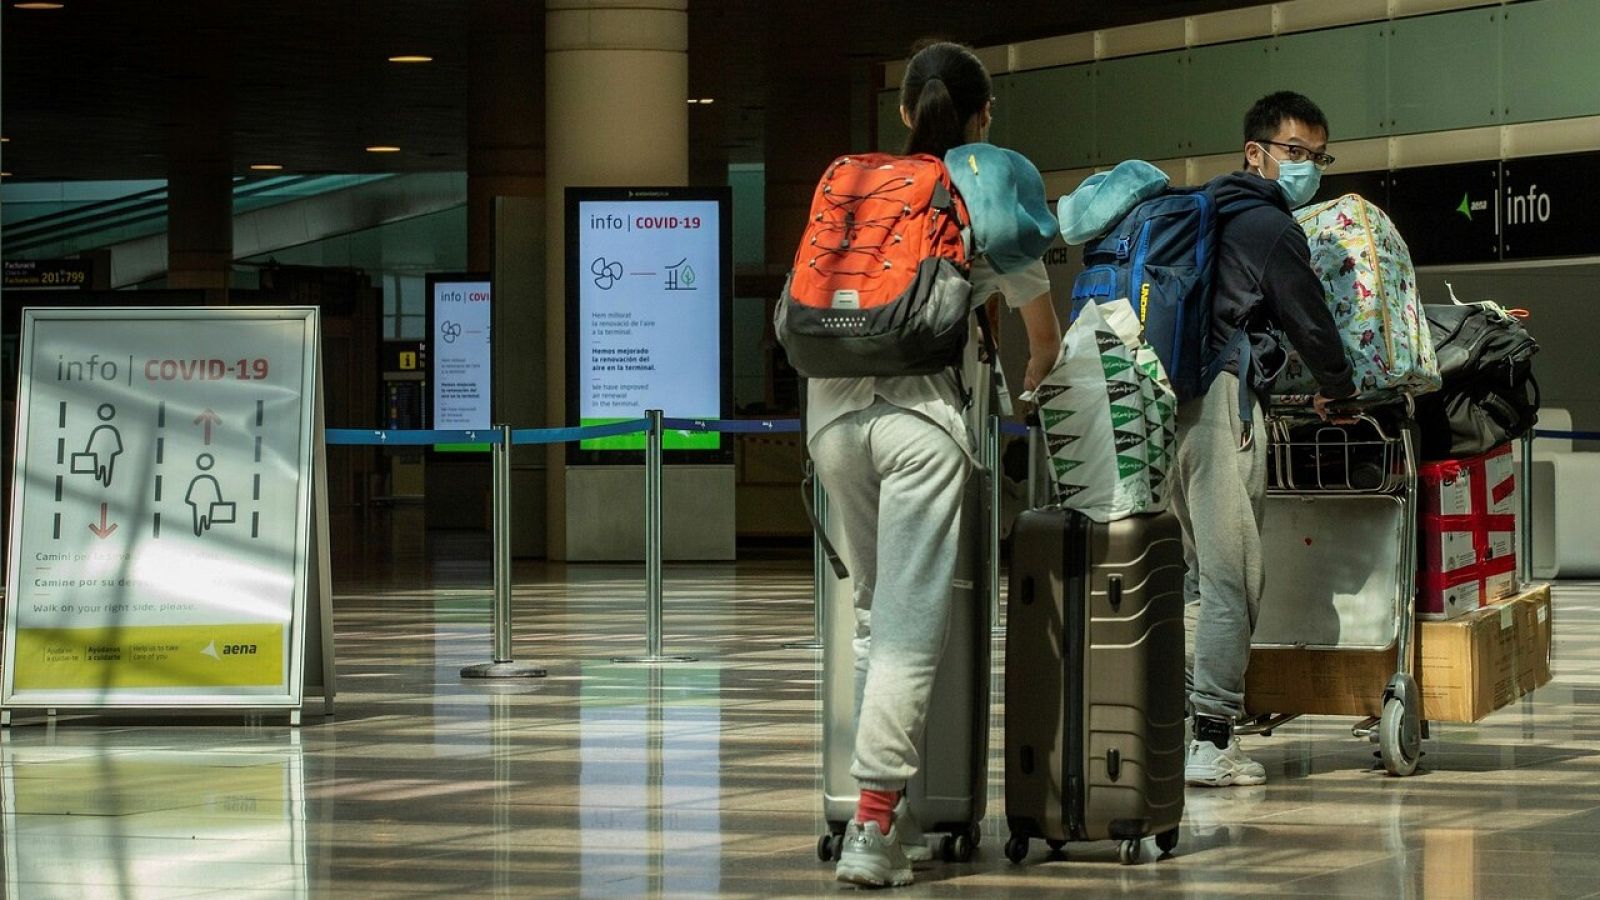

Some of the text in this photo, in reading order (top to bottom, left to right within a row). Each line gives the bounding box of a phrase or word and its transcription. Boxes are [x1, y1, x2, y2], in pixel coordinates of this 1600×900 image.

[1507, 184, 1550, 225] info
[590, 214, 701, 230] info COVID-19
[440, 291, 461, 302] info
[592, 347, 649, 356] Hemos mejorado
[57, 354, 269, 381] info COVID-19
[34, 578, 75, 588] Camine
[79, 579, 97, 589] por
[101, 579, 114, 587] su
[33, 604, 57, 613] Walk
[61, 605, 74, 613] on
[78, 605, 100, 615] your
[104, 604, 129, 614] right
[223, 644, 257, 655] aena
